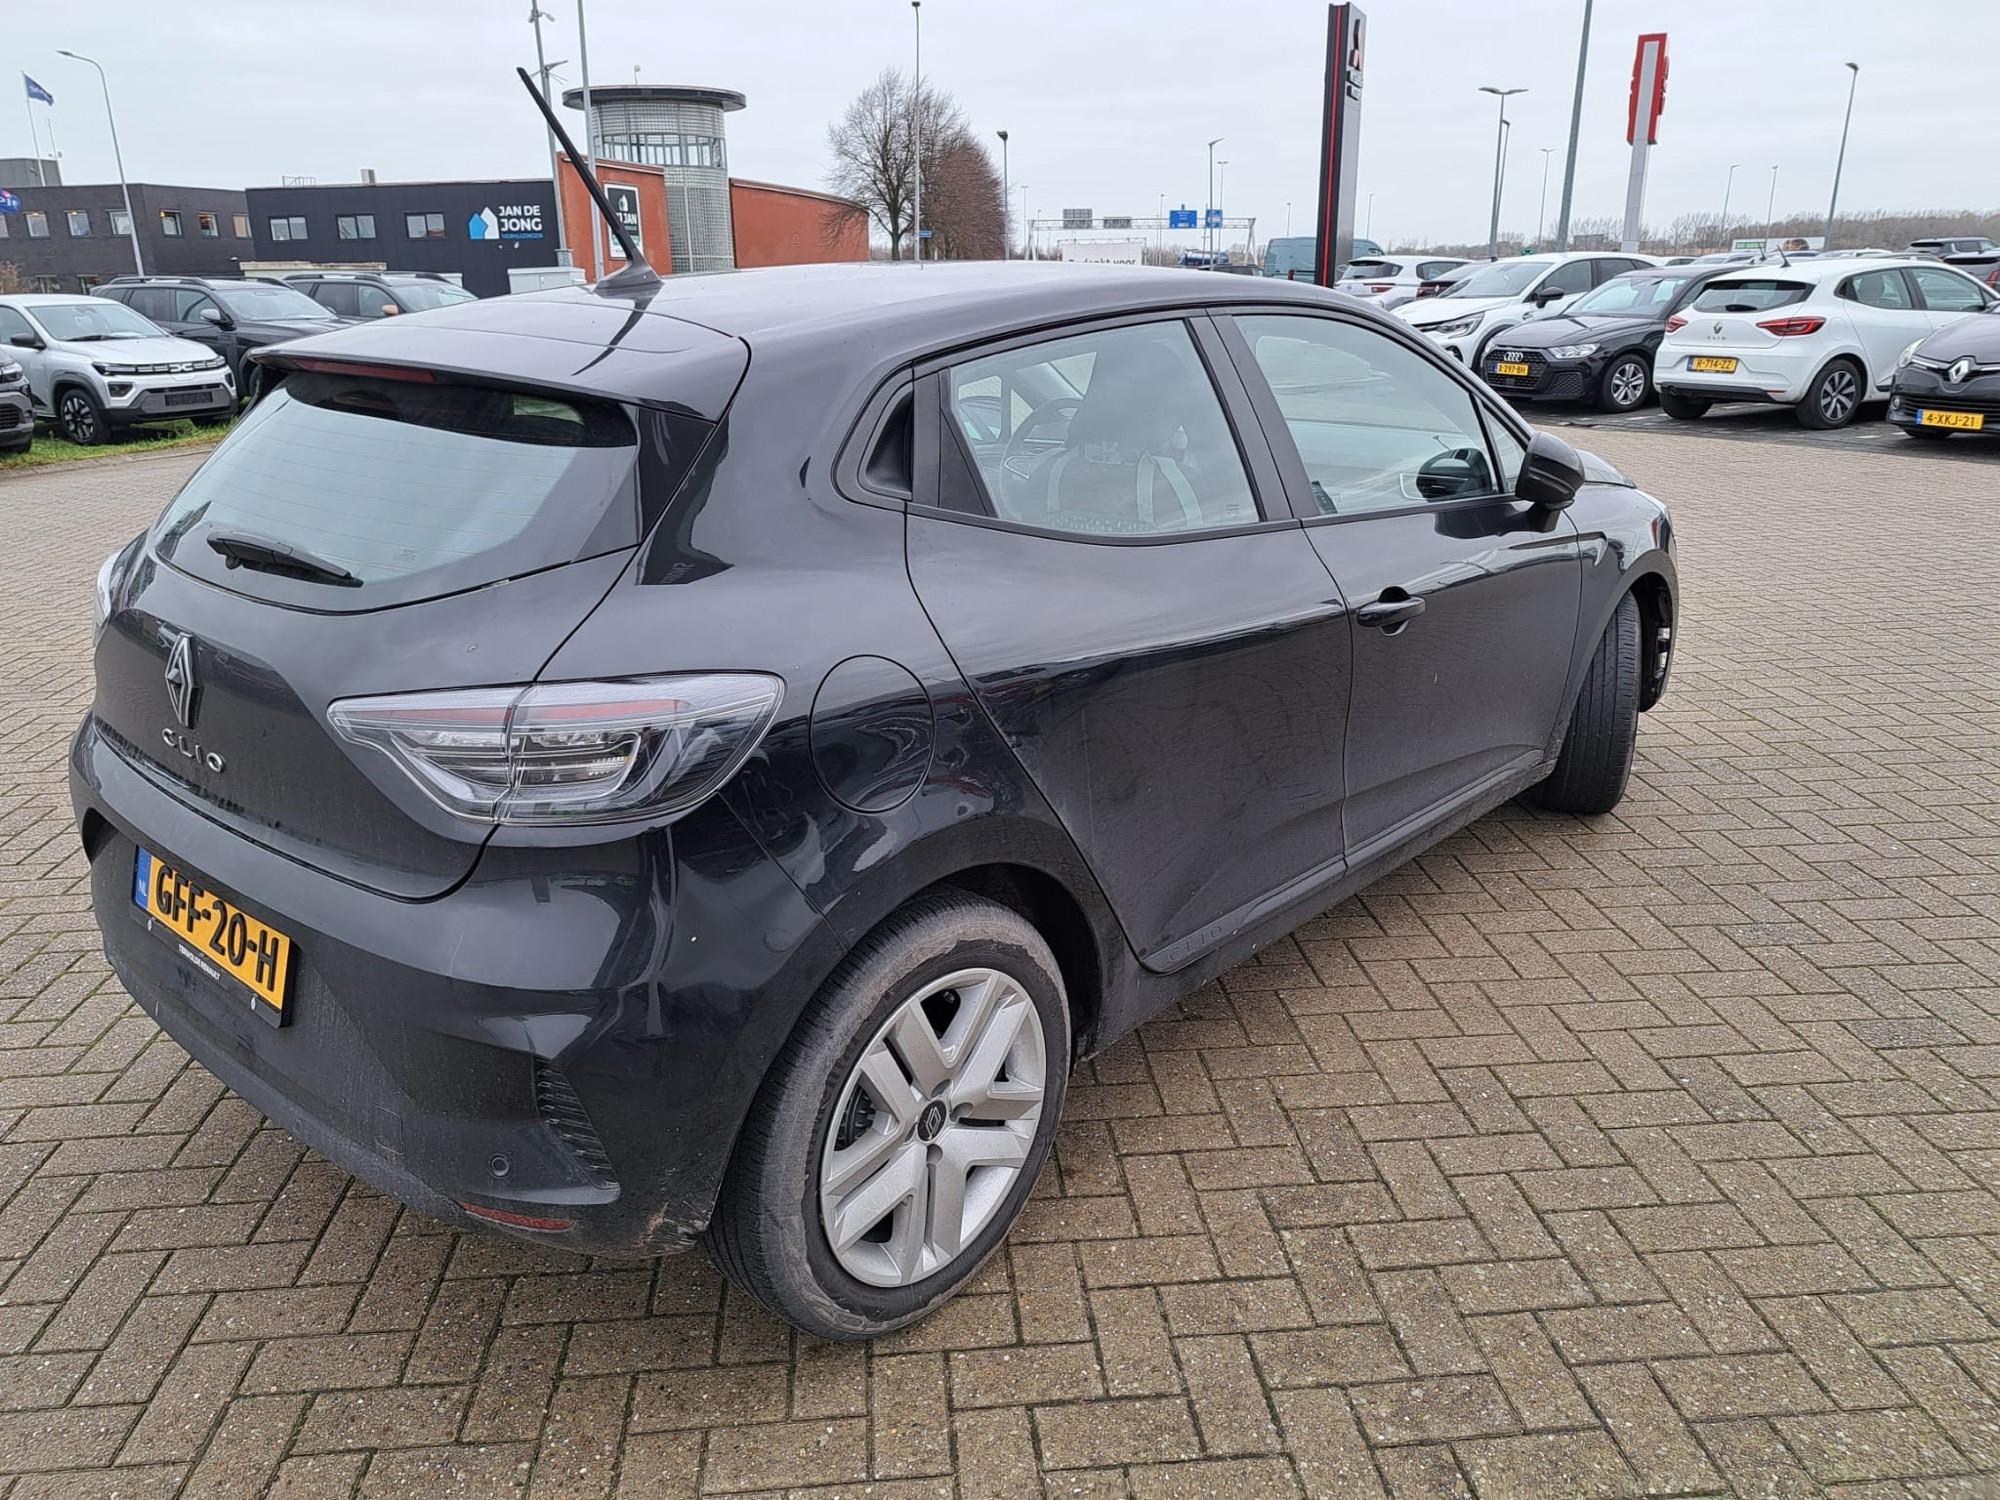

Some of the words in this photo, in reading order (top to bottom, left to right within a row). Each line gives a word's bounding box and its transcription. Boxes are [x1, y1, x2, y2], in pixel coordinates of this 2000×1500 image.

[498, 205, 522, 216] JAN
[523, 205, 541, 216] DE
[500, 218, 542, 231] JONG
[1926, 413, 1975, 427] 4-XKJ-21
[162, 728, 223, 773] CLIO
[155, 864, 279, 993] GFF-20-H
